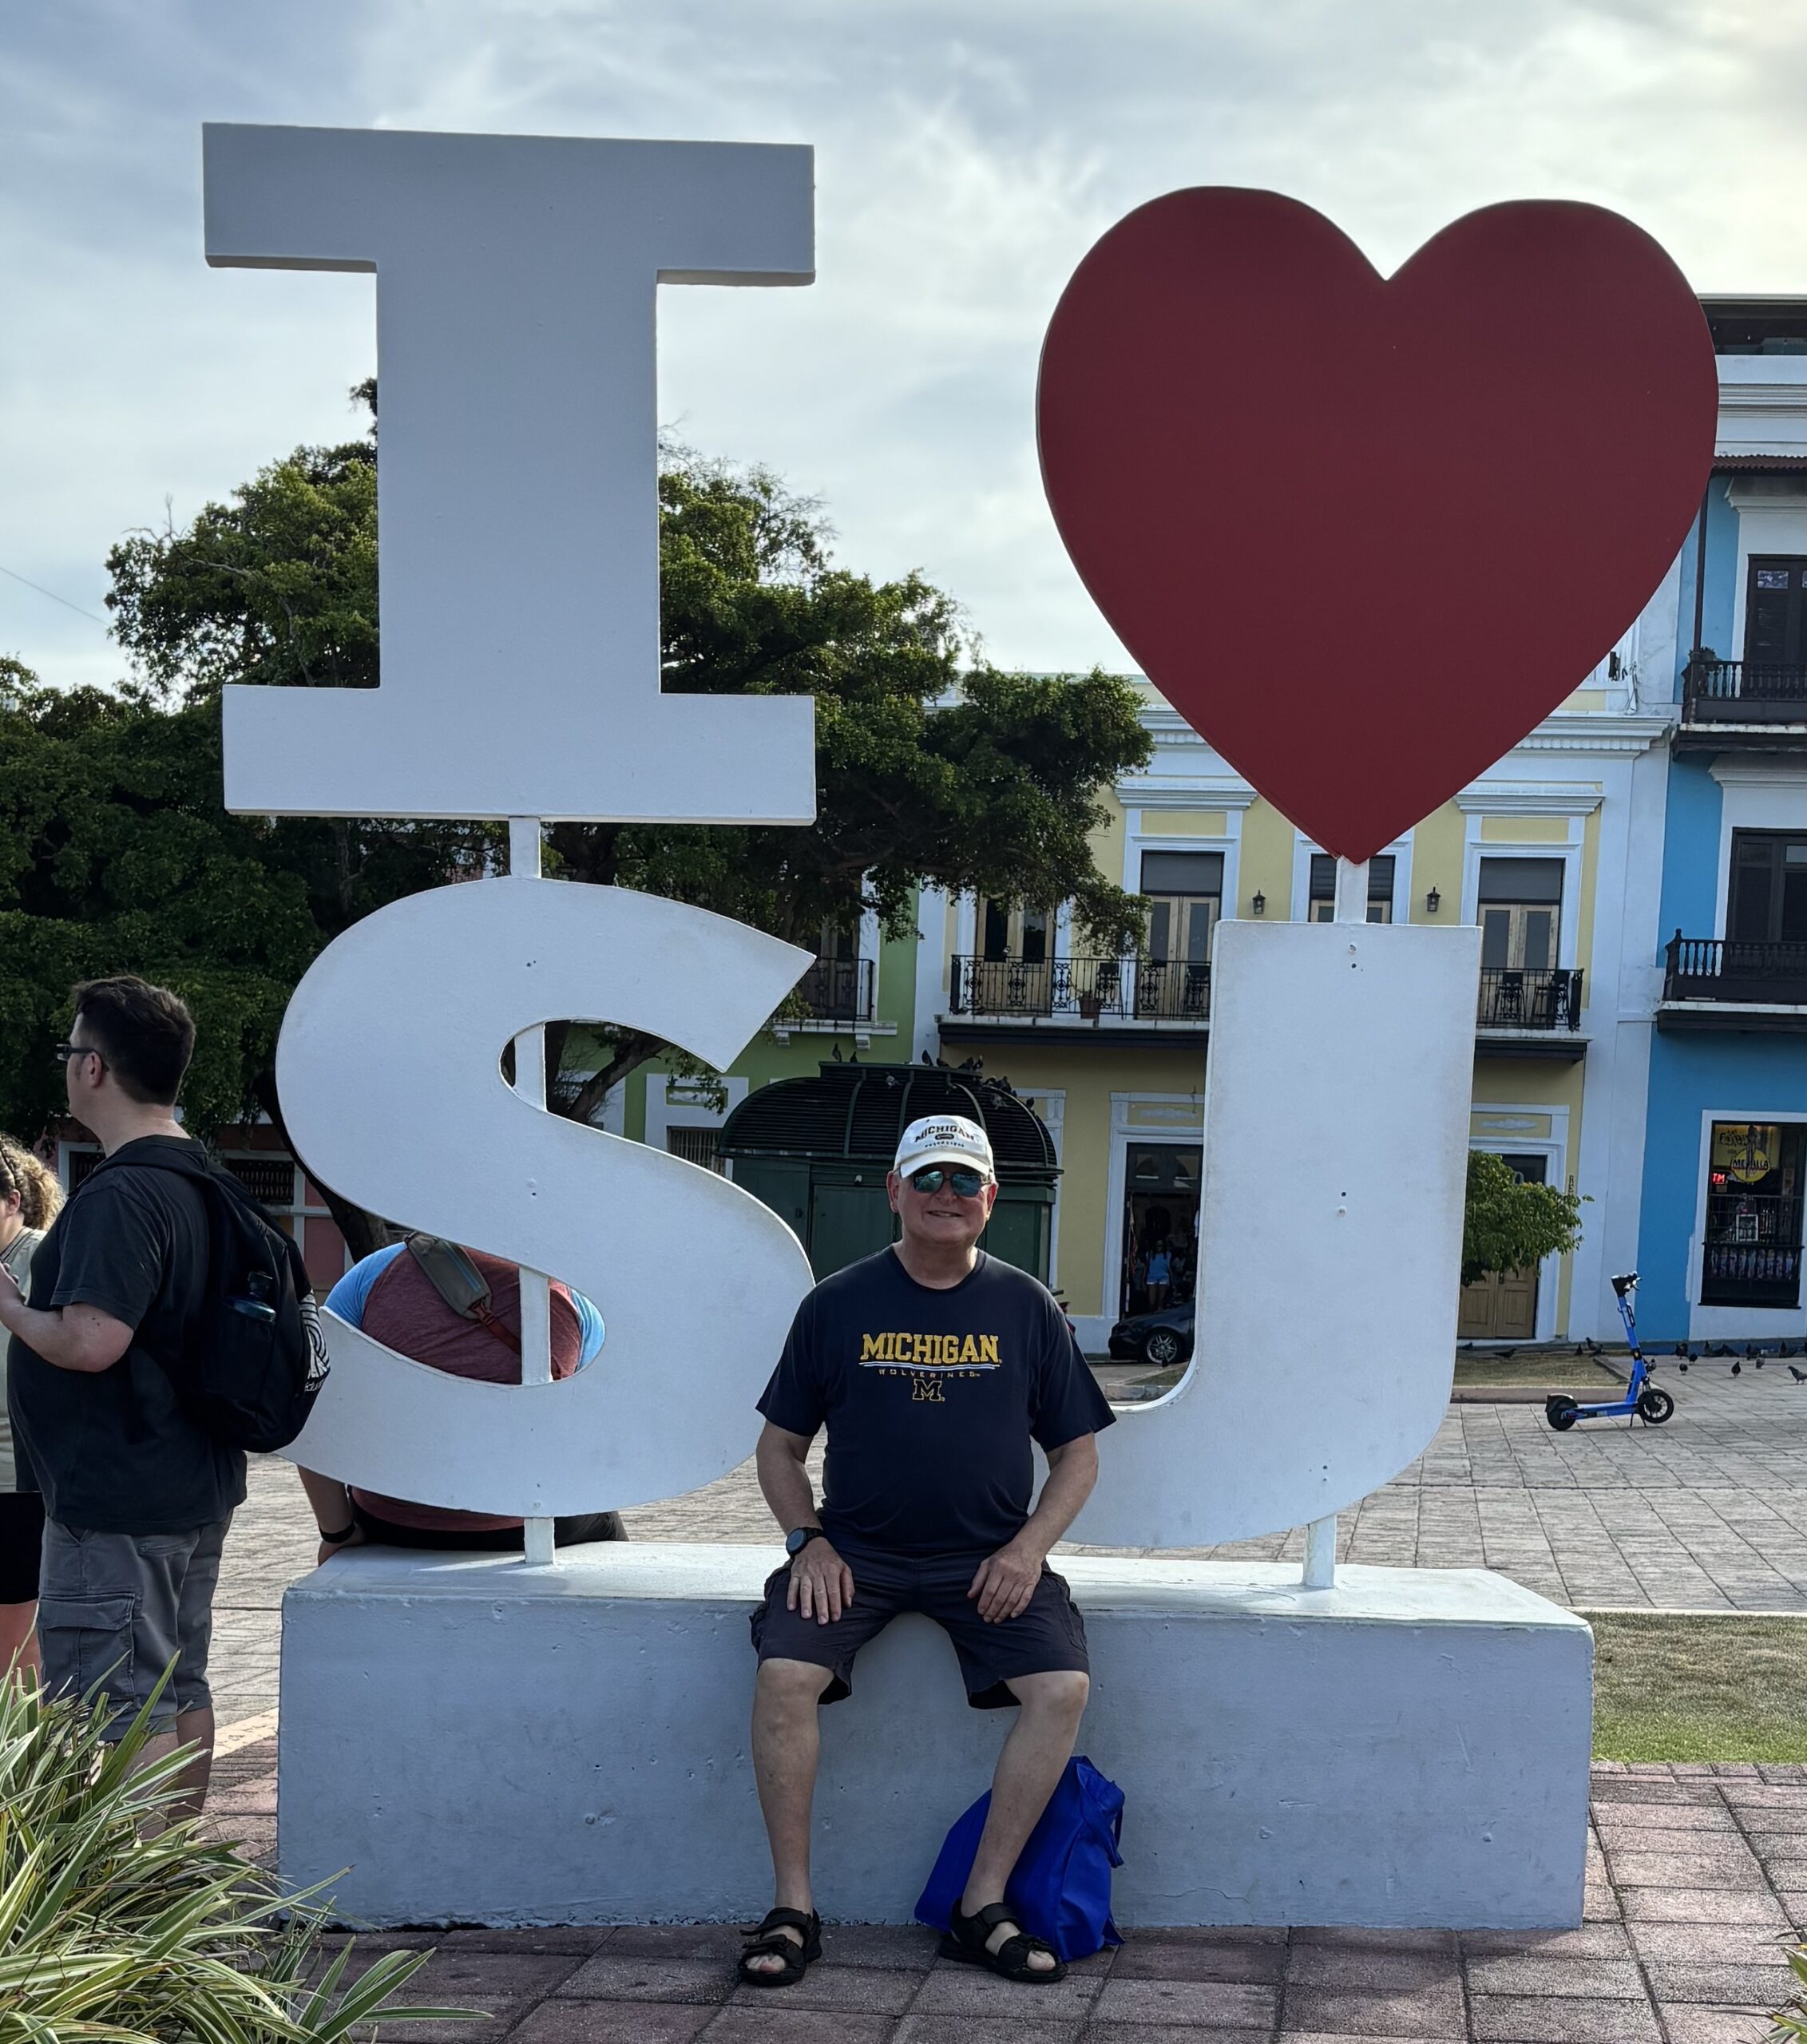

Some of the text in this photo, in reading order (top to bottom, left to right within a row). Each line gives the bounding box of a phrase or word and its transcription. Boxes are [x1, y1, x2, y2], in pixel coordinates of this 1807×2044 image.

[203, 121, 816, 826] I
[914, 1125, 974, 1143] MICHIGAN
[860, 1332, 999, 1365] MICHIGAN
[878, 1368, 977, 1380] WOLVERINES
[912, 1378, 943, 1402] M
